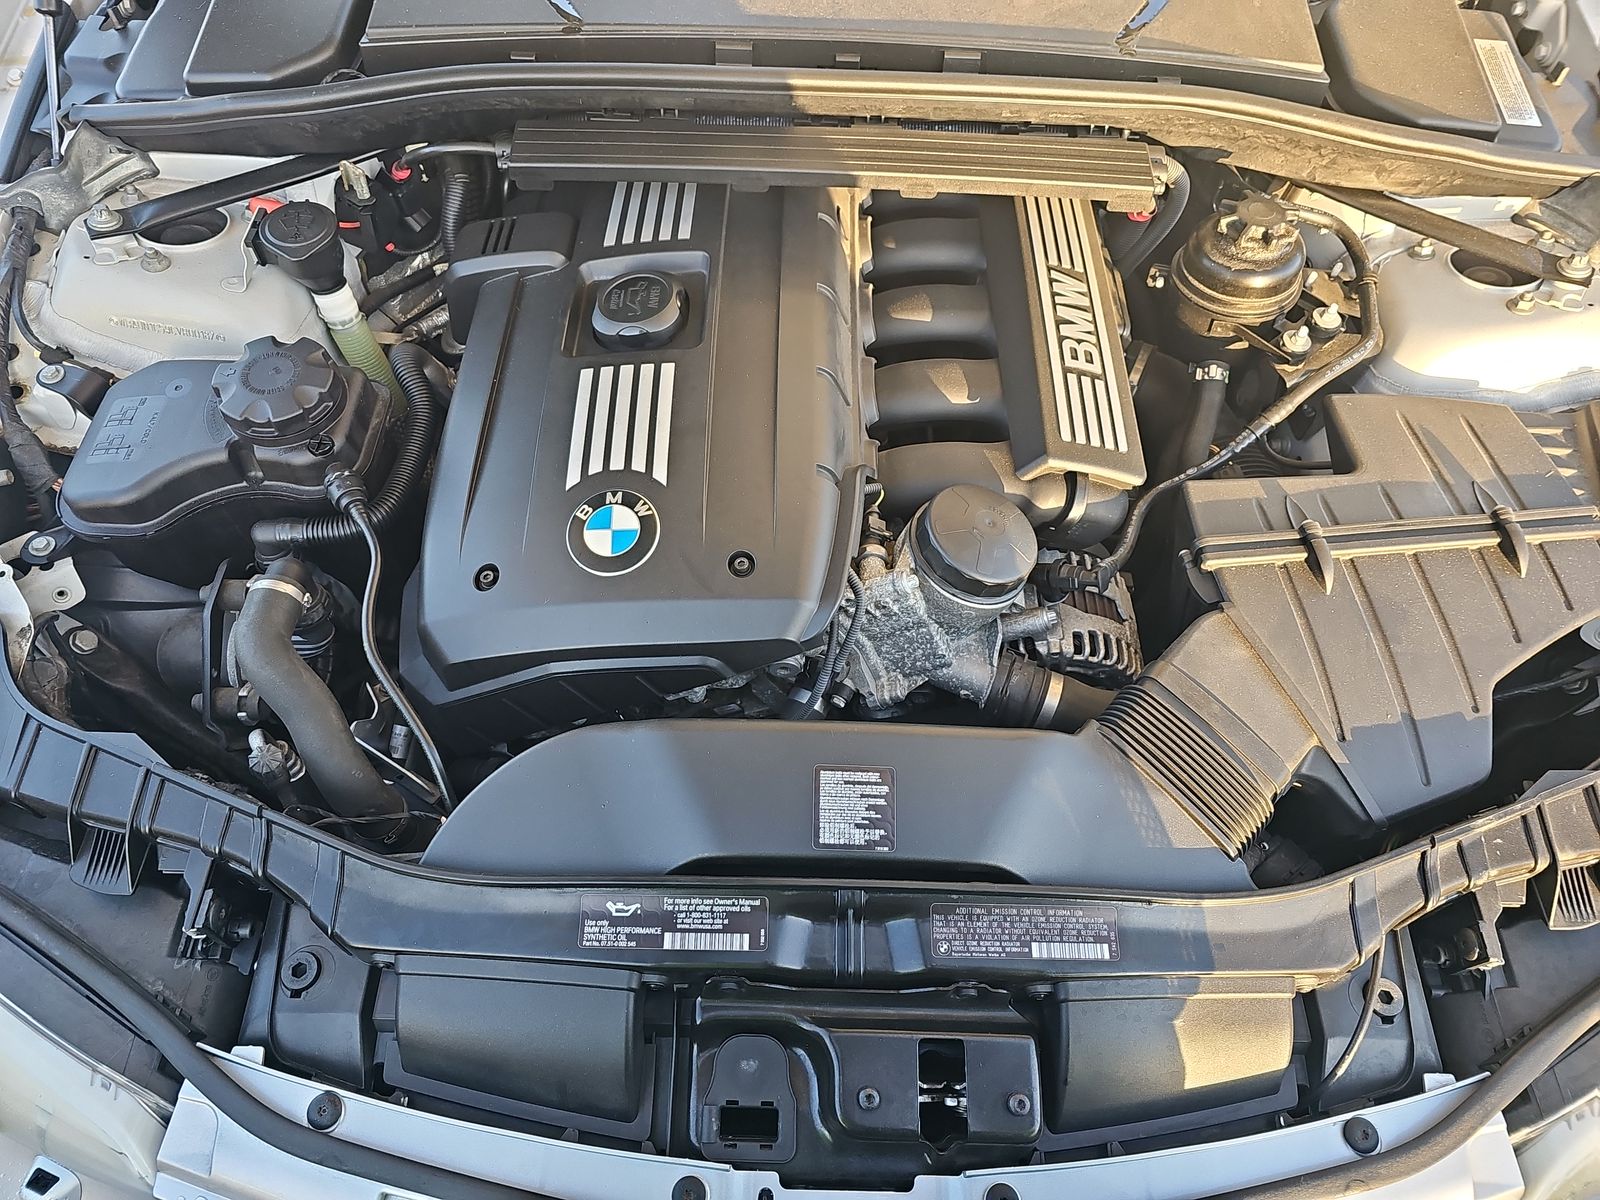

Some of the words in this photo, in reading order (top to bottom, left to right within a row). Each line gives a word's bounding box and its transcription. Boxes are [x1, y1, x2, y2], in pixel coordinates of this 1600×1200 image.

[648, 286, 660, 308] BMW
[1050, 269, 1102, 375] BMW
[576, 491, 653, 520] BMW
